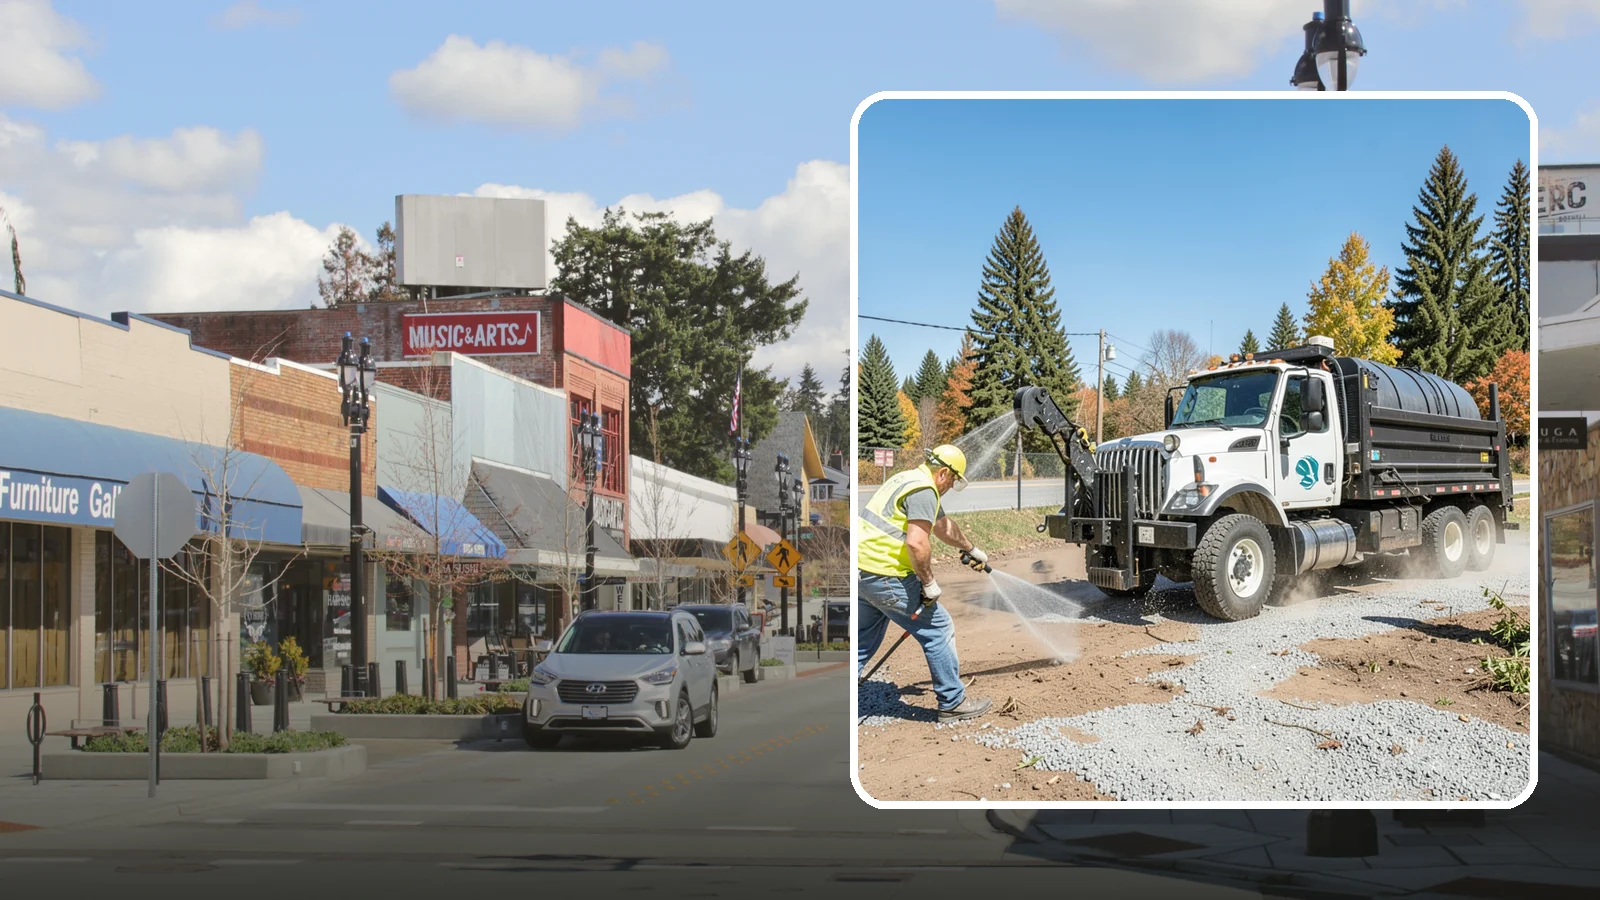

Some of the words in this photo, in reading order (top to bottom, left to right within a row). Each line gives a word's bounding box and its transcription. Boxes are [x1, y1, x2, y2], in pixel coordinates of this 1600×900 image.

[1540, 427, 1577, 437] UGA
[0, 471, 79, 515] Furniture
[453, 563, 480, 575] SUSHI
